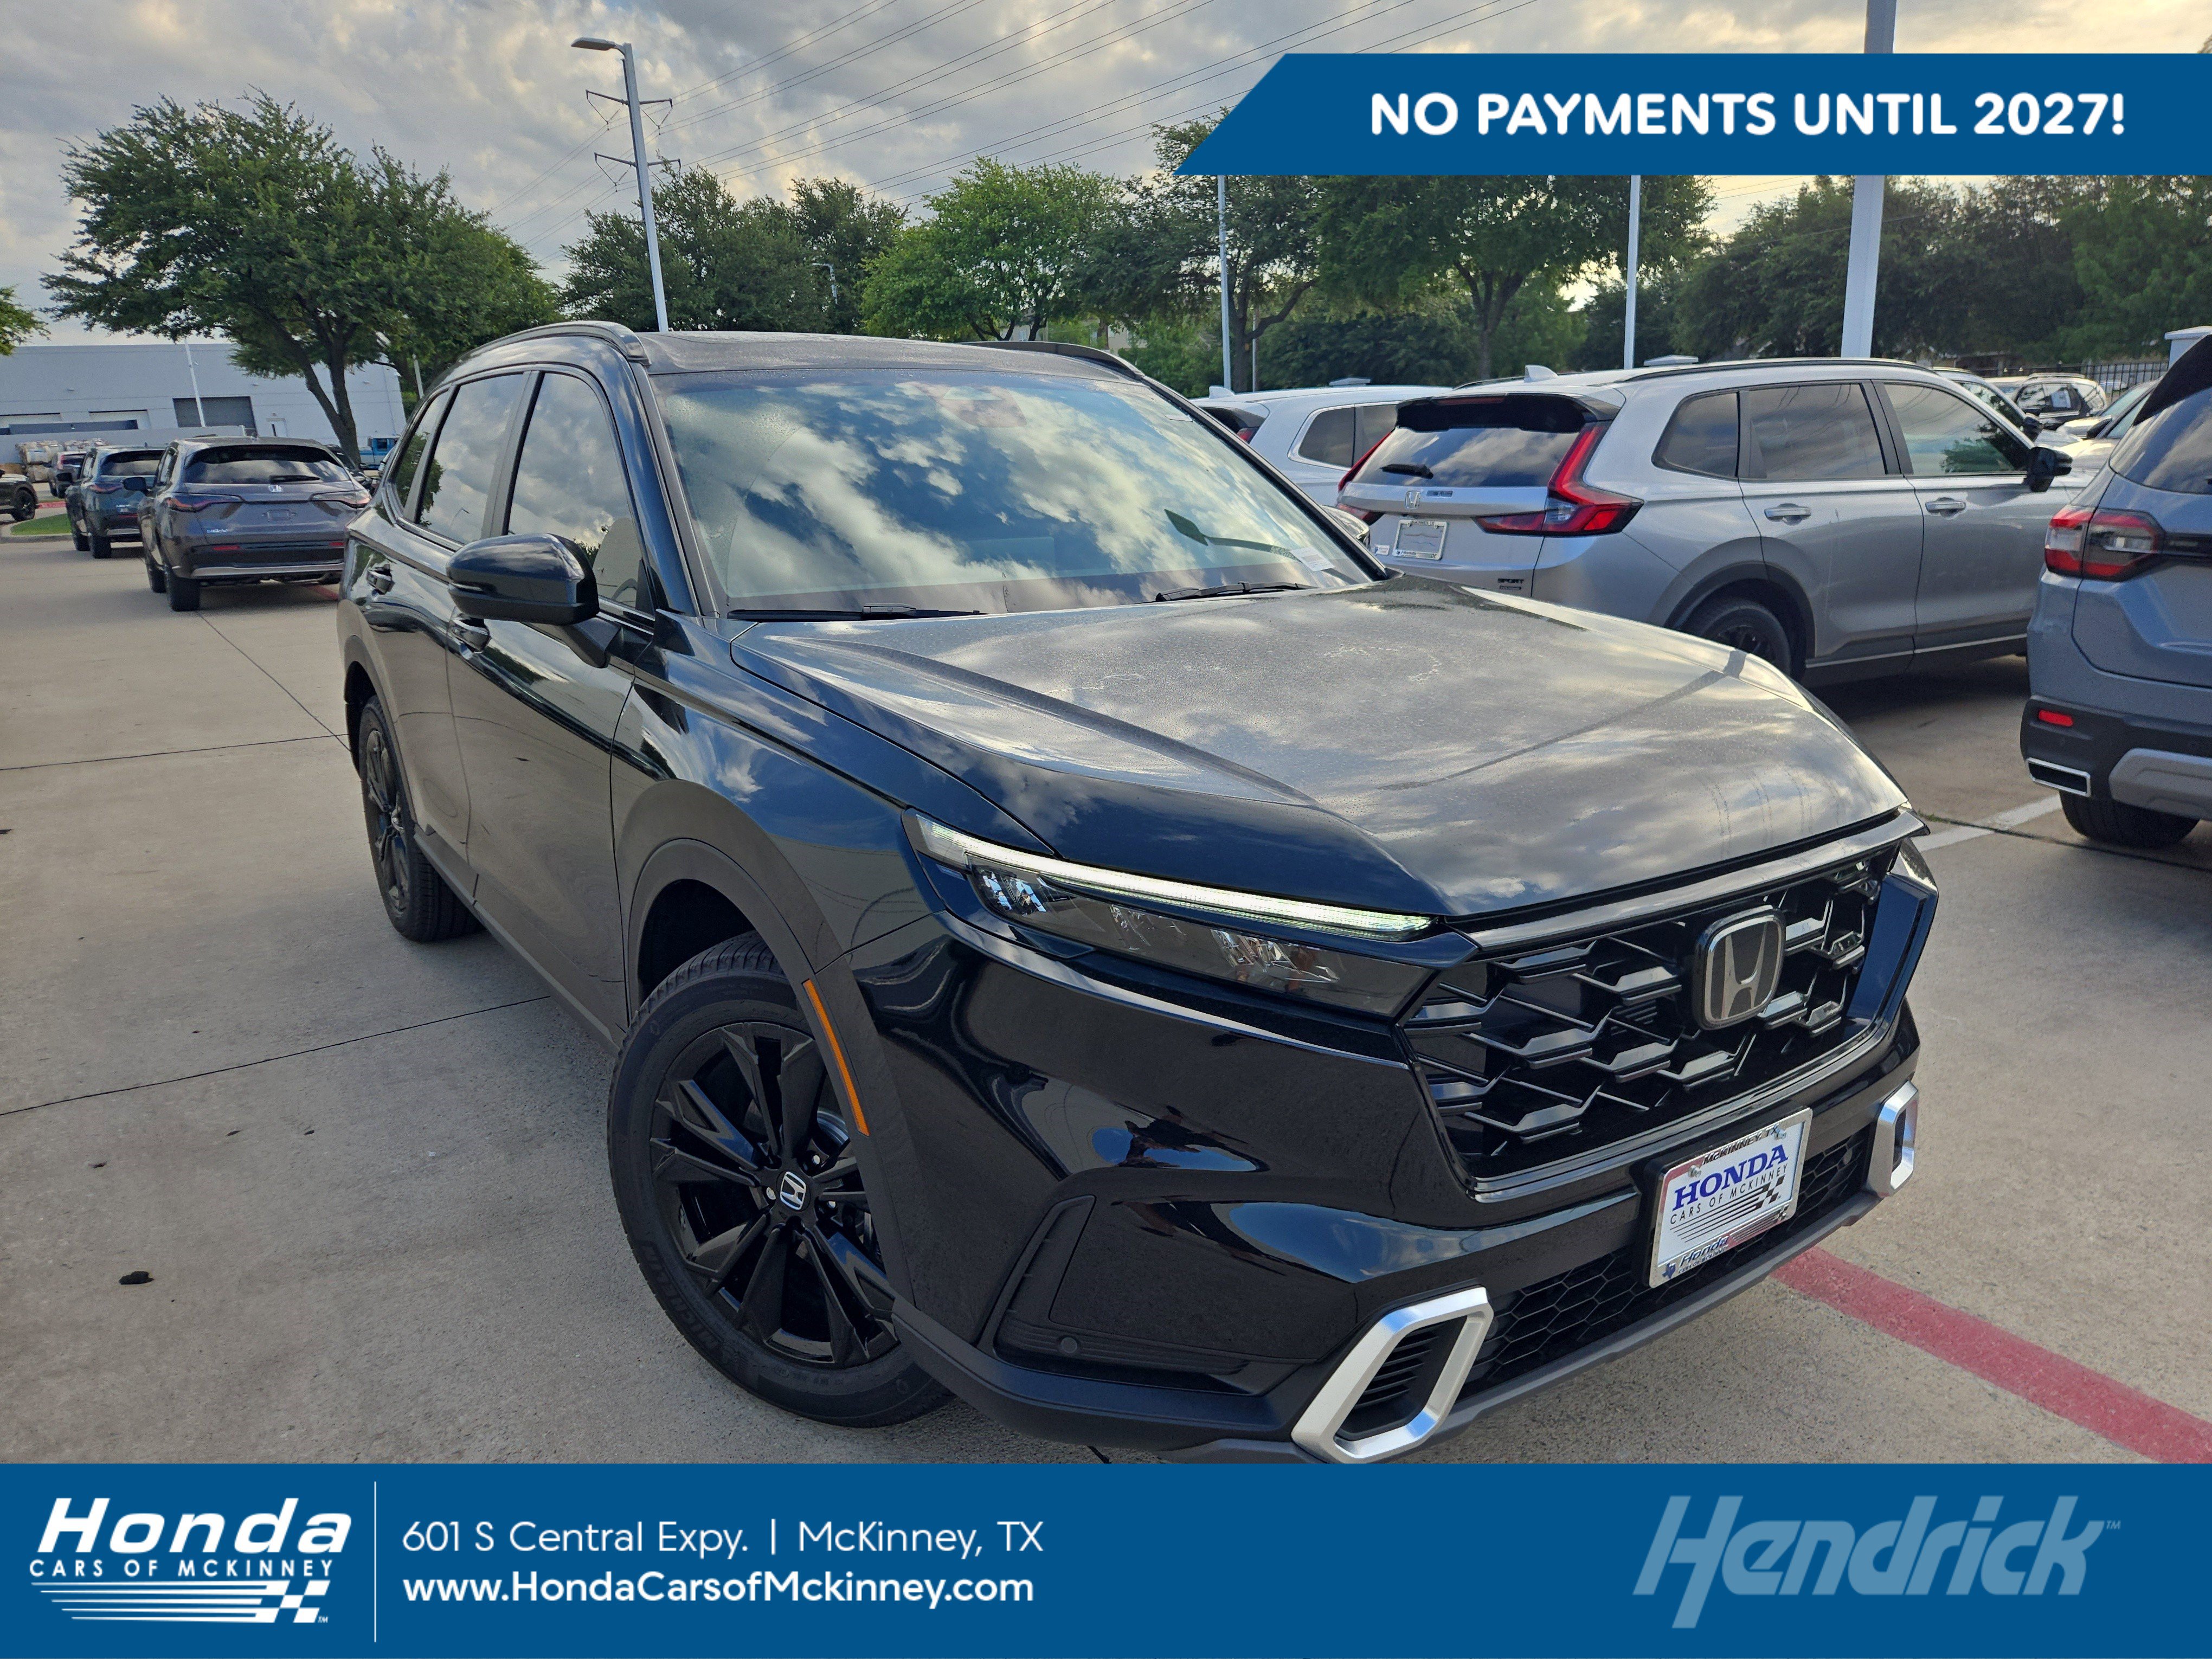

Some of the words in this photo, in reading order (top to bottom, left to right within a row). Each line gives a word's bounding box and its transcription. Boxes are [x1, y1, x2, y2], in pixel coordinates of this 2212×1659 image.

[1670, 1203, 1701, 1224] CARS
[1709, 1193, 1723, 1207] OF
[1729, 1163, 1787, 1199] MCKINNEY
[1672, 1144, 1788, 1211] HONDA
[1679, 1236, 1729, 1268] Honda
